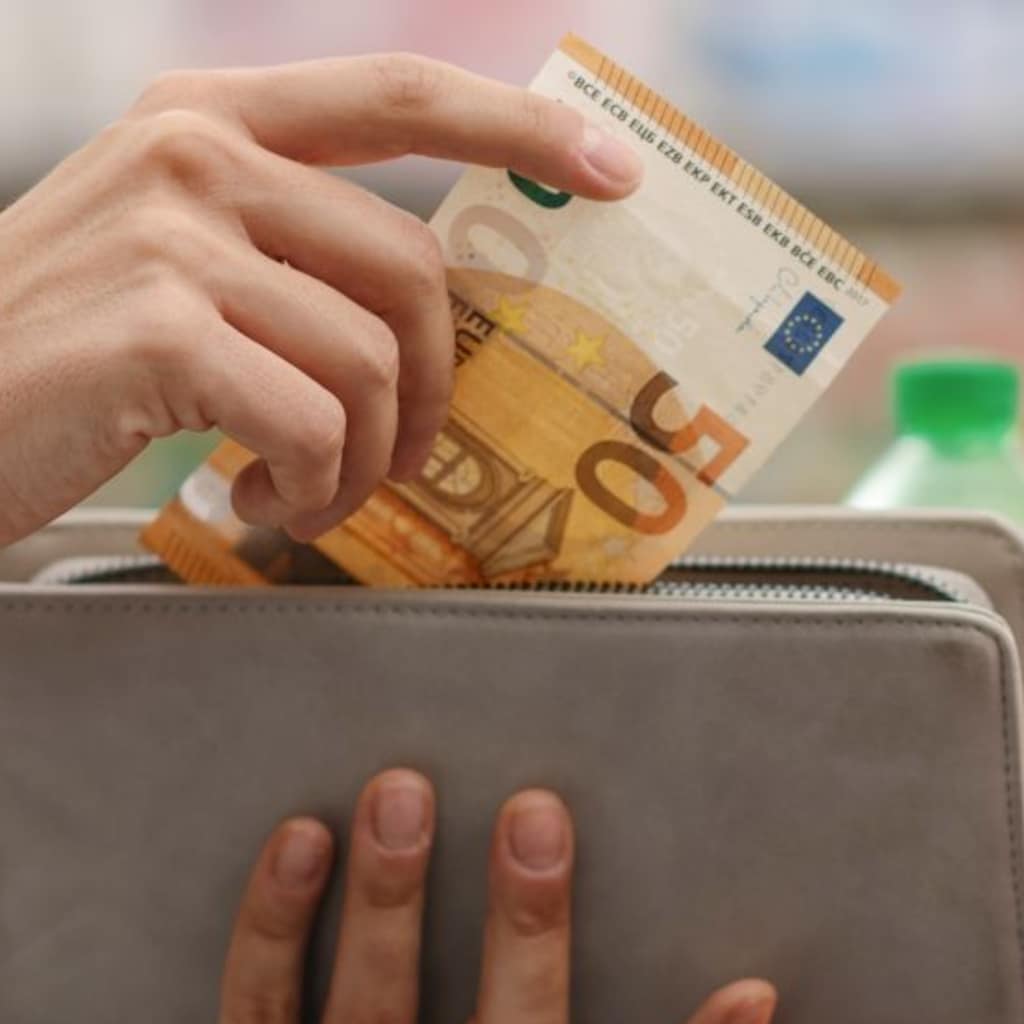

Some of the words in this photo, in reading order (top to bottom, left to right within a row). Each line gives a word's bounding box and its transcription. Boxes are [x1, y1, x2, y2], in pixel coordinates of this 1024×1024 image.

[601, 98, 629, 122] ECB
[656, 140, 684, 164] EZB
[683, 160, 711, 184] EKP
[709, 182, 738, 205] EKT
[736, 202, 763, 227] ESB
[763, 223, 791, 248] EKB
[817, 266, 845, 291] EBC
[575, 369, 751, 536] 50
